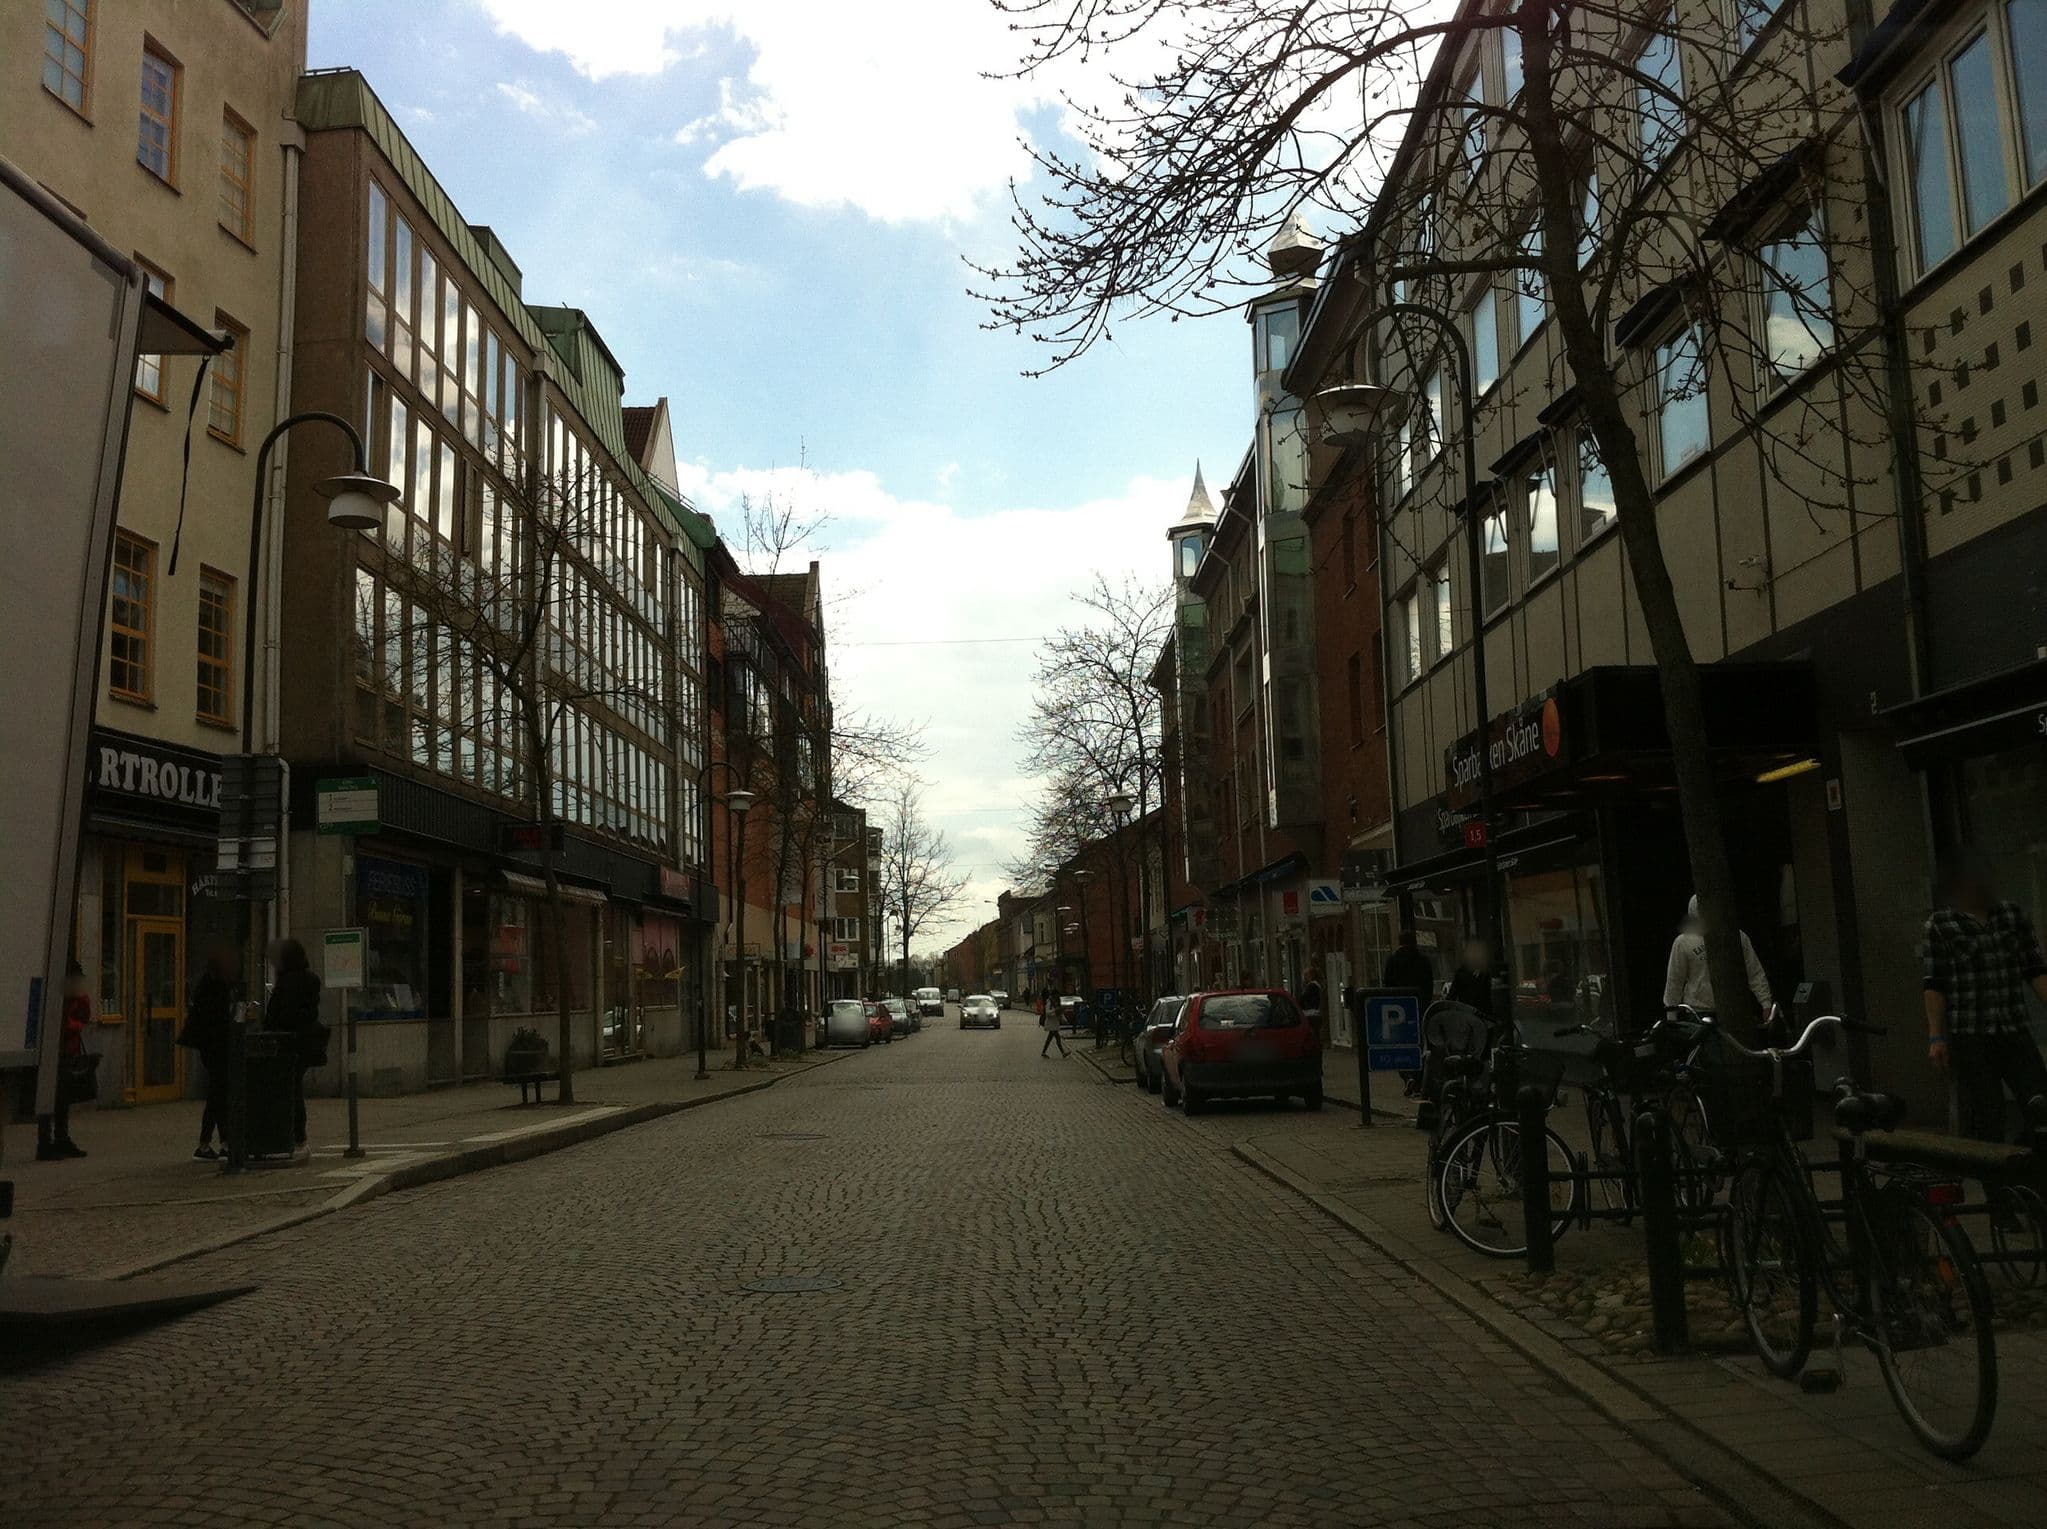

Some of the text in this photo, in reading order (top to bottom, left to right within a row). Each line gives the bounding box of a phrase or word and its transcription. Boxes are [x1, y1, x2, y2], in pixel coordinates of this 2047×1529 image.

[1452, 719, 1539, 792] Sparbaen Skåne
[1382, 1004, 1406, 1040] P
